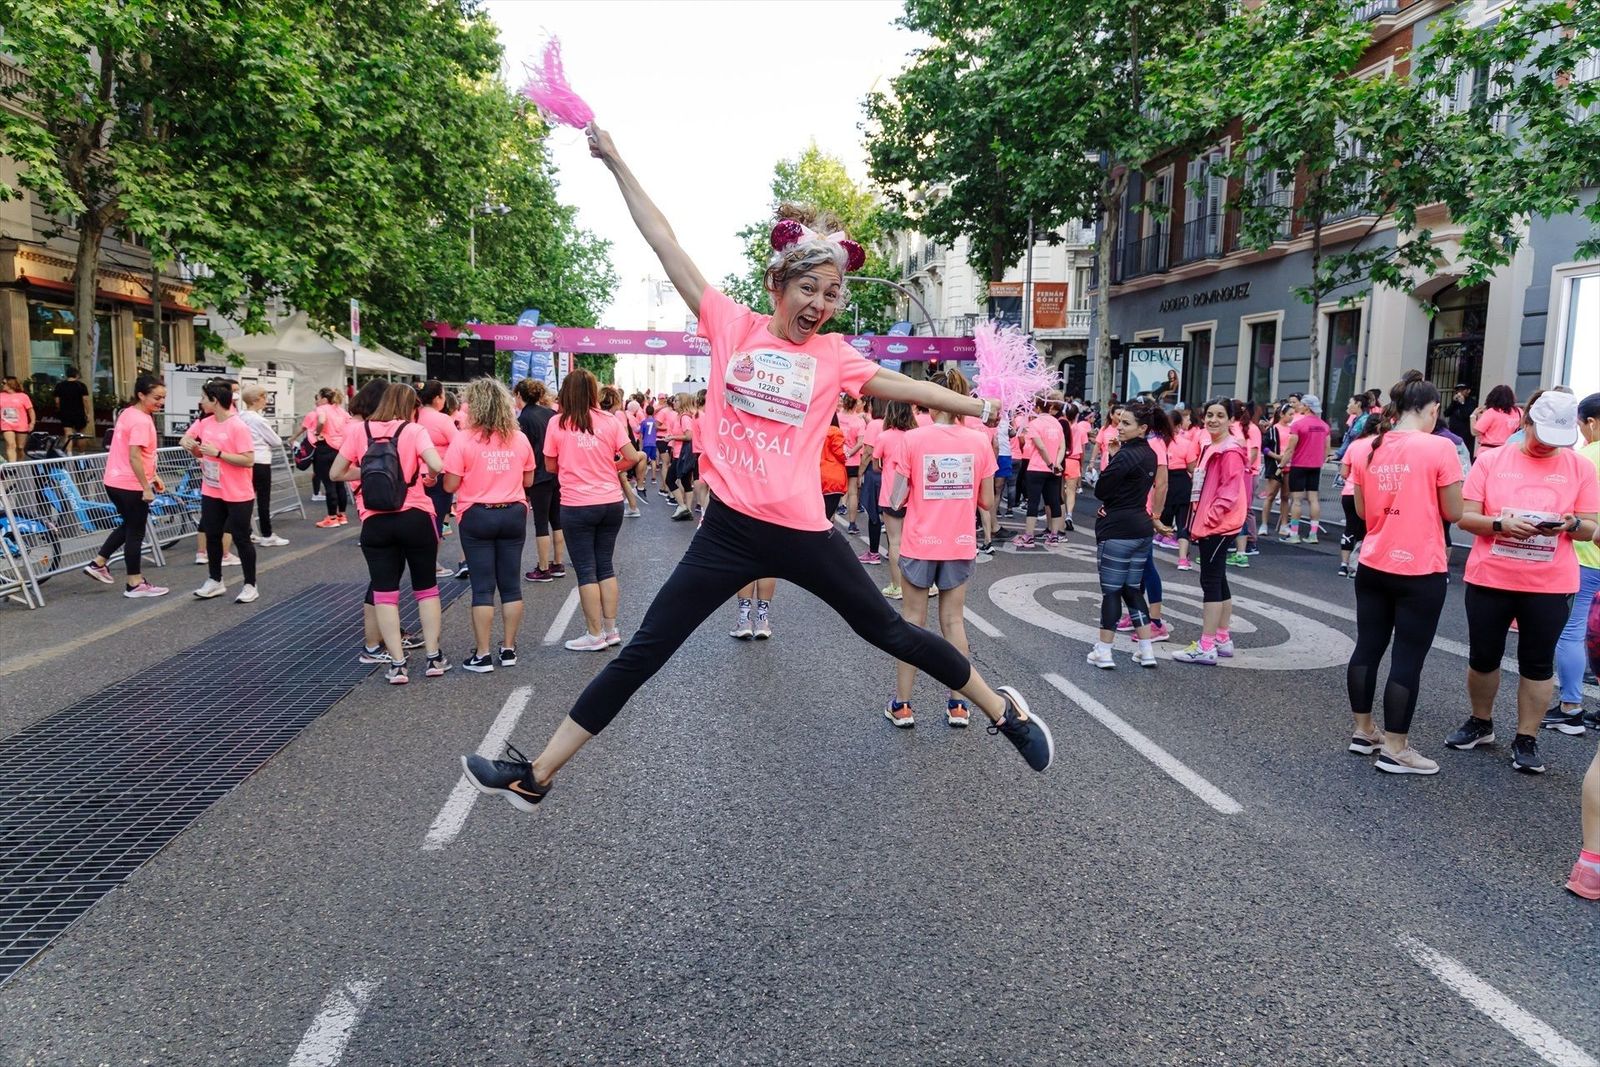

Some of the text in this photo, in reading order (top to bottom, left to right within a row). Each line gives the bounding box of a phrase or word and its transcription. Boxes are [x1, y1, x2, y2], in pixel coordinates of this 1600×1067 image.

[1159, 281, 1252, 312] ADOLFO DOMINGUEZ
[1131, 348, 1182, 362] LOEWE
[758, 356, 789, 368] ASTURIANA
[756, 370, 785, 385] 016
[758, 383, 780, 394] 12283
[731, 395, 755, 408] OYSHO
[733, 386, 757, 398] CARRERA
[772, 396, 788, 405] MUJER
[774, 408, 800, 420] Santander
[646, 421, 654, 435] 7
[718, 418, 791, 457] DORSAL
[482, 451, 515, 459] CARRERA
[717, 443, 768, 477] SUMA
[487, 464, 511, 472] MUJER
[1379, 473, 1391, 482] DE
[1378, 482, 1402, 490] MUJE
